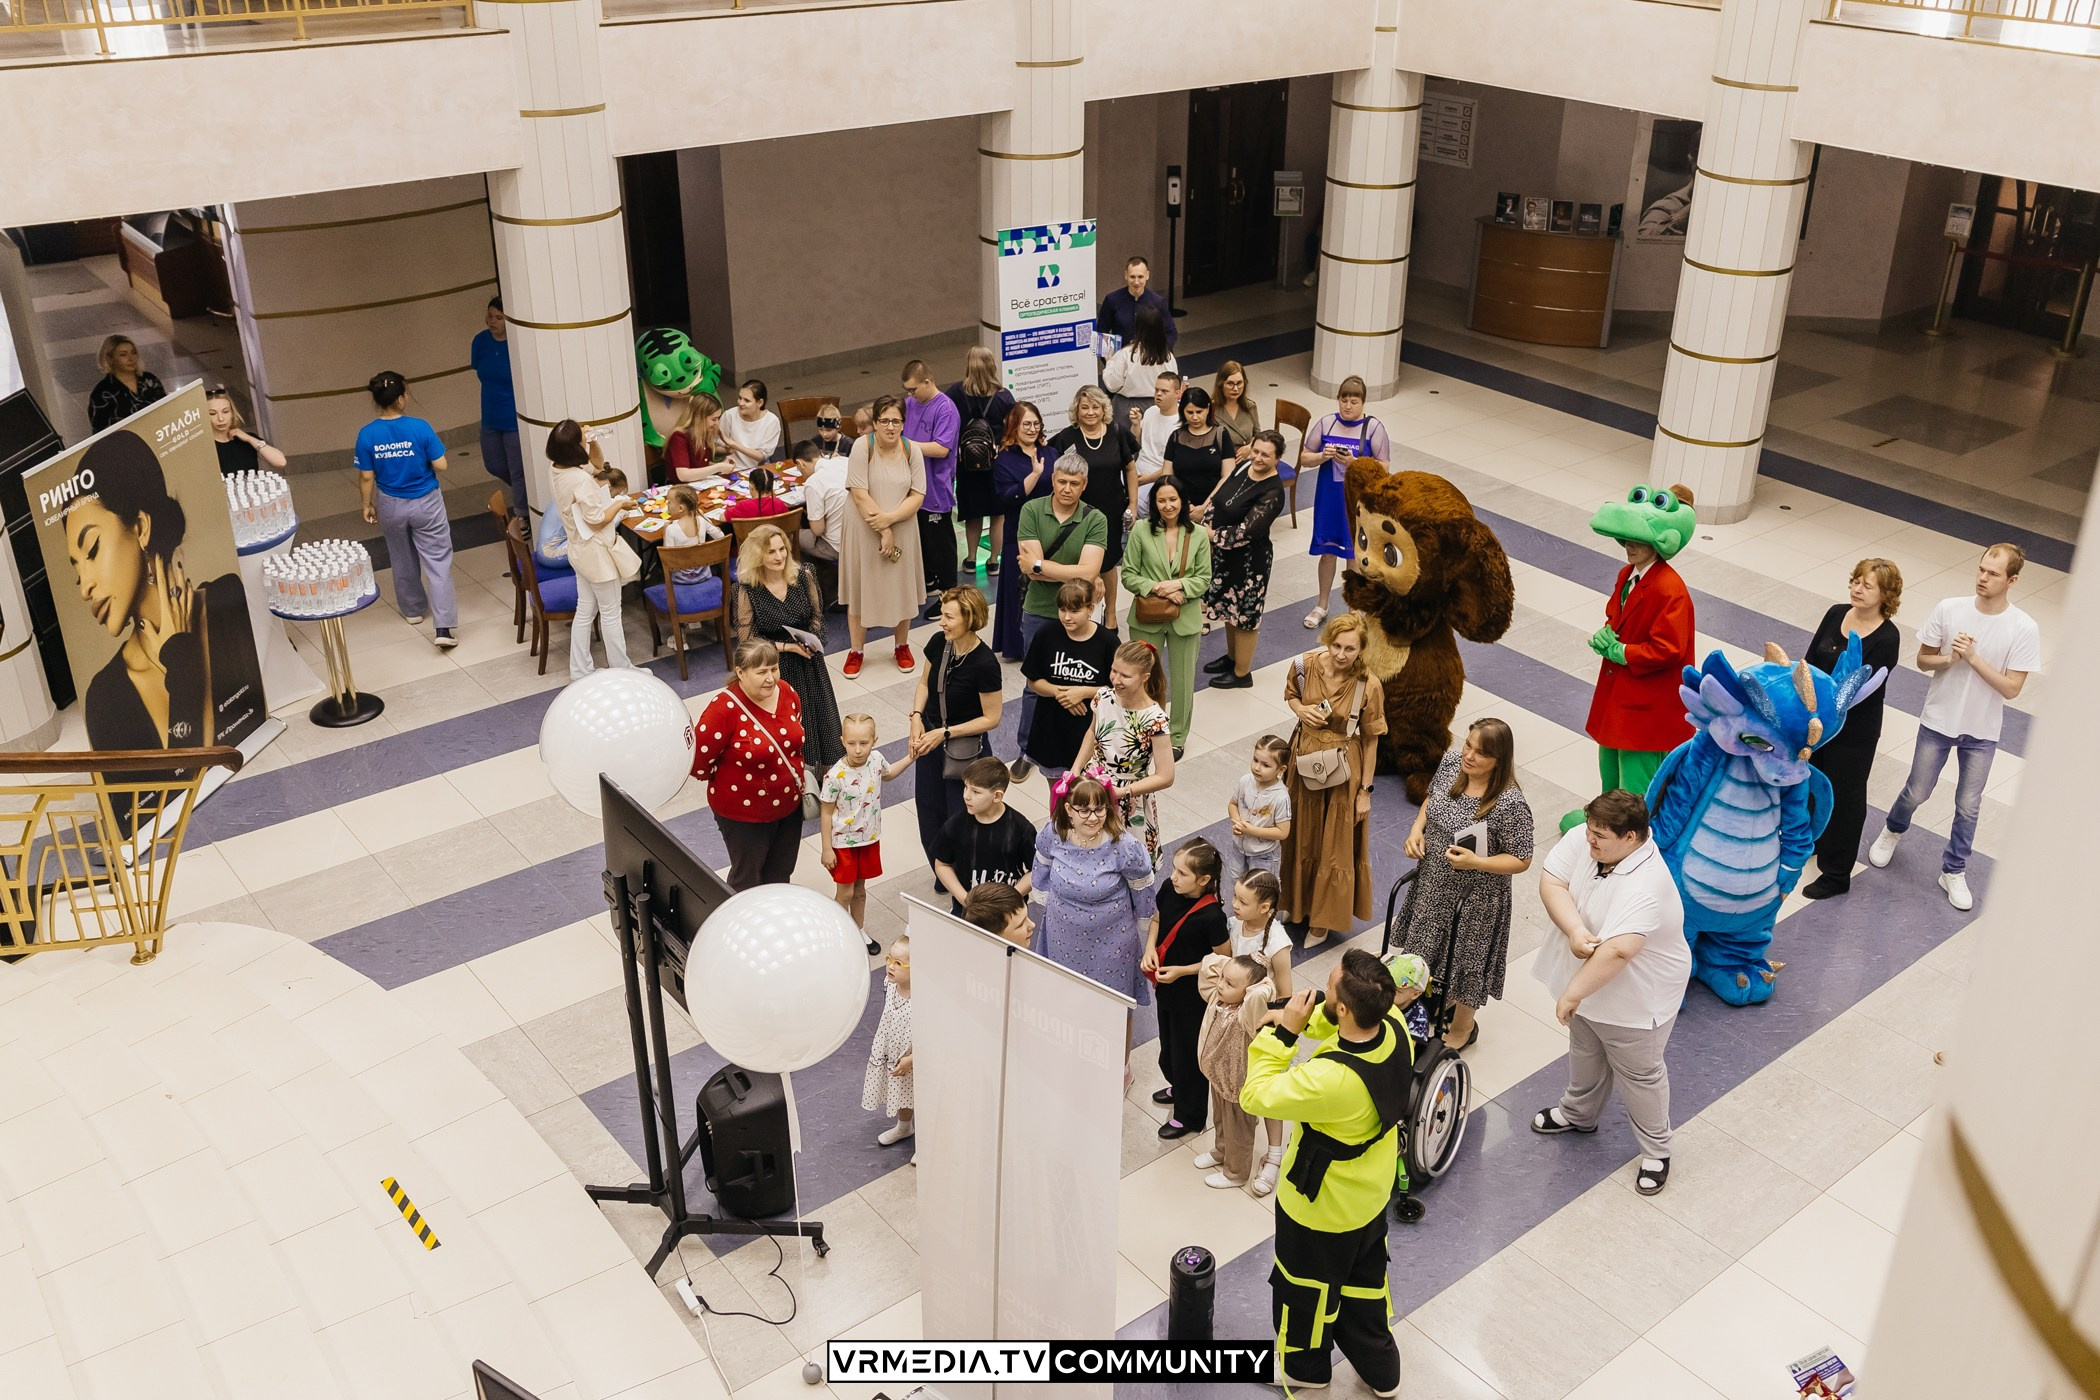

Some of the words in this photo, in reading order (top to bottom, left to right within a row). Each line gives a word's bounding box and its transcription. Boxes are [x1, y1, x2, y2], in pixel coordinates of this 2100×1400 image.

[1011, 298, 1030, 310] Всё
[1033, 289, 1086, 308] срастётся!
[172, 429, 190, 443] GOLD
[374, 450, 415, 459] КУЗБАССА
[39, 469, 95, 513] РИНГО
[1050, 651, 1097, 680] House
